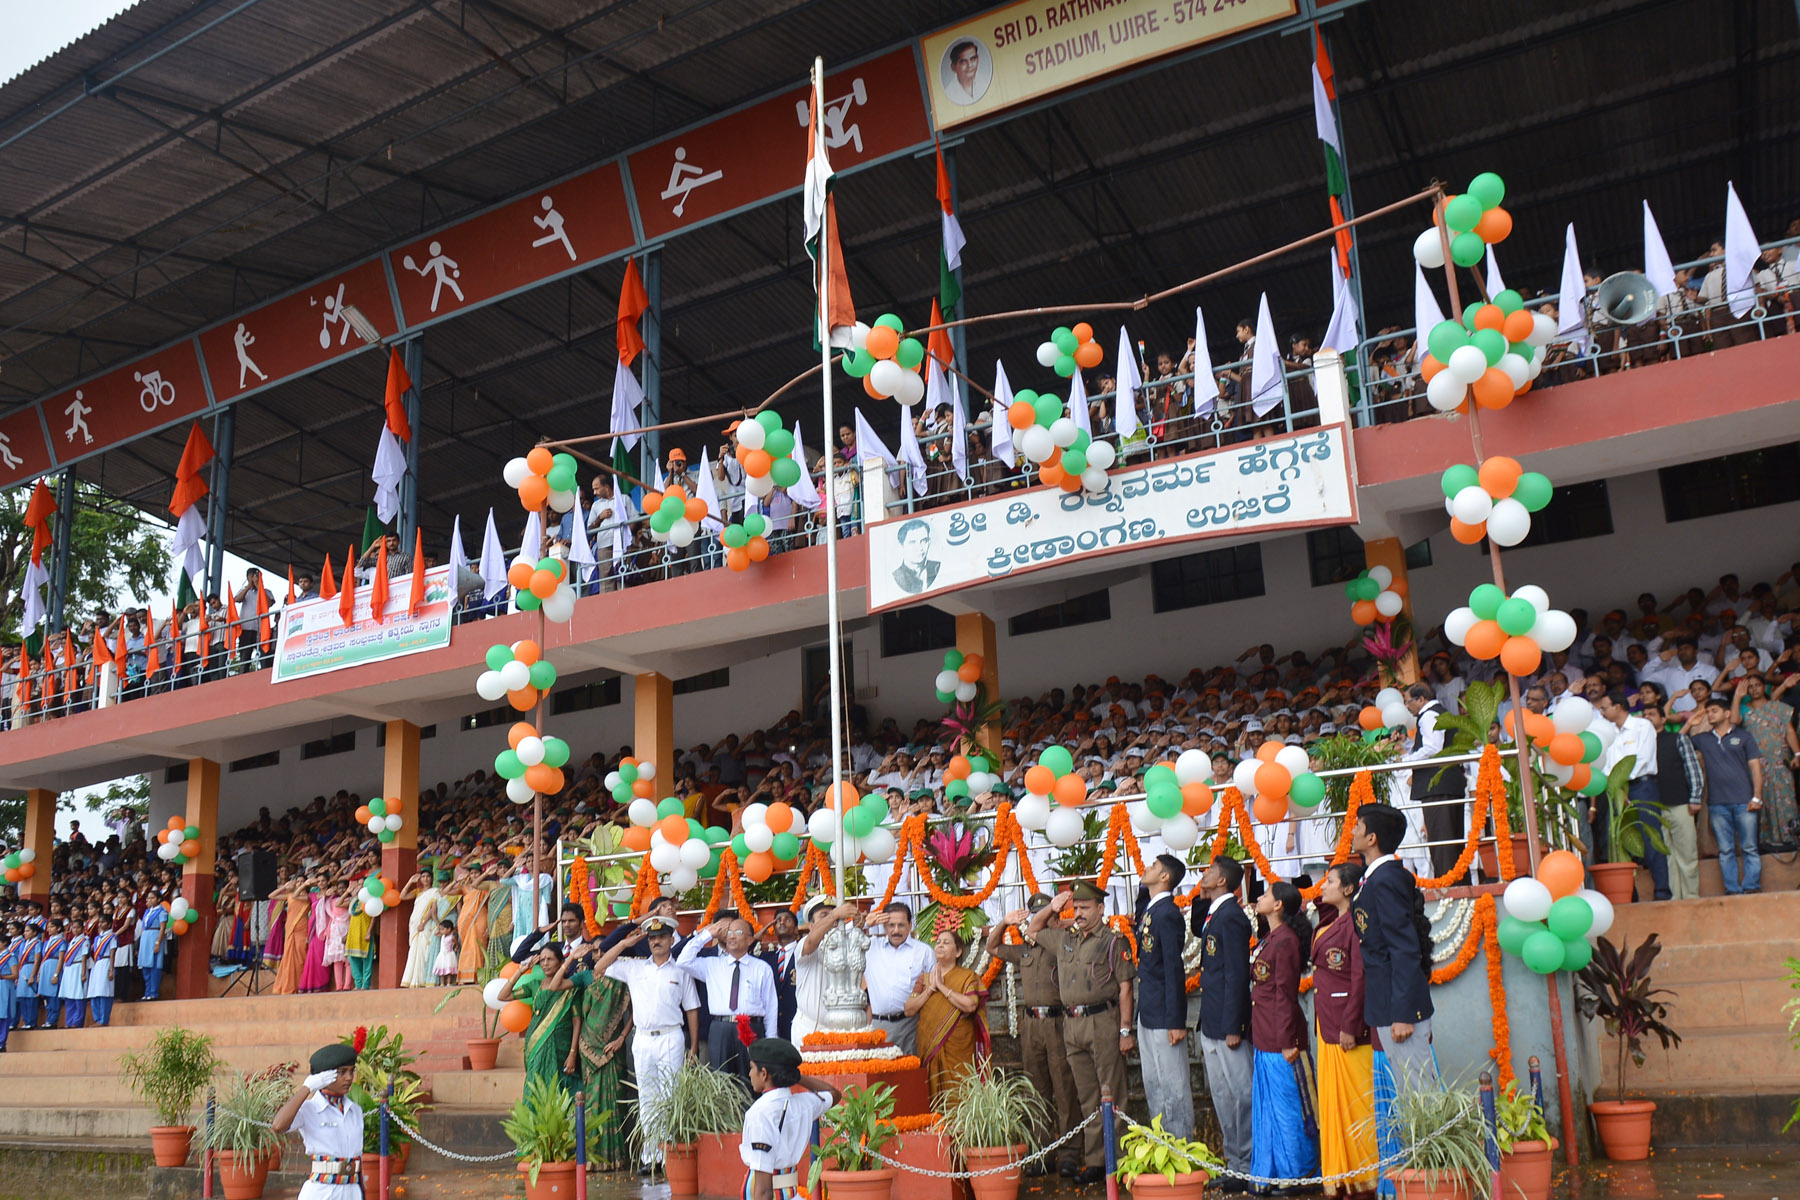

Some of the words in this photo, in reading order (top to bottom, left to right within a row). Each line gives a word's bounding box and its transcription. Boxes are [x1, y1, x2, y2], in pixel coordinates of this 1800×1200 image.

[994, 20, 1022, 48] SRI
[1025, 15, 1043, 38] D.
[1024, 30, 1106, 75] STADIUM,
[1108, 9, 1160, 45] UJIRE
[1173, 0, 1207, 24] 574
[946, 512, 987, 546] ಶ್ರೀ
[1005, 502, 1040, 525] ಡಿ.
[1238, 431, 1332, 481] ಹೆಗ್ಗಡೆ
[986, 516, 1165, 578] ಕ್ರೀಡಾಂಗಣ,
[1186, 484, 1291, 528] ಉಜಿರೆ
